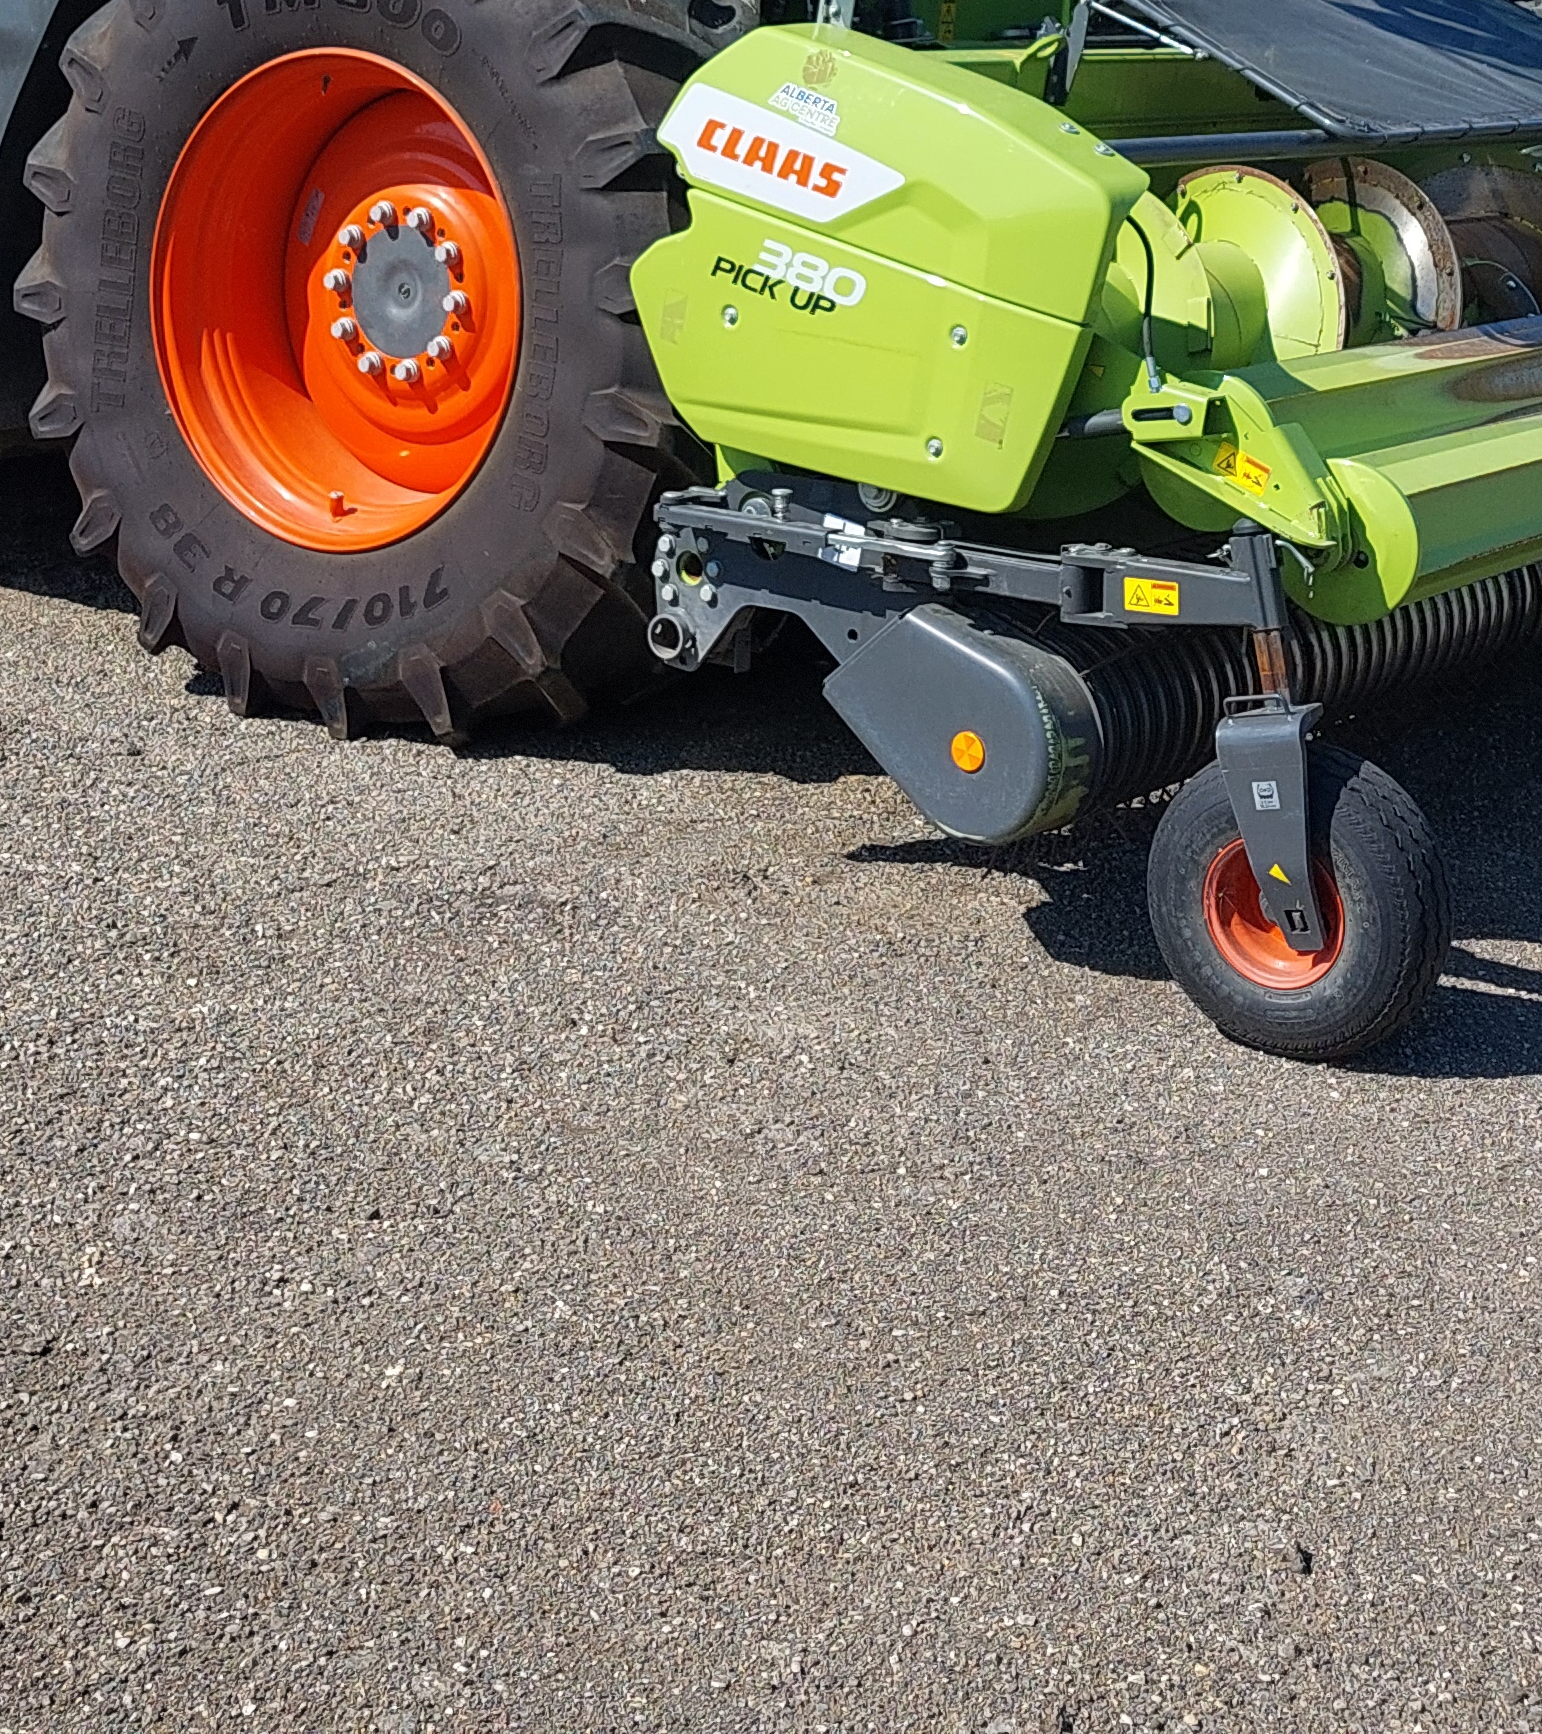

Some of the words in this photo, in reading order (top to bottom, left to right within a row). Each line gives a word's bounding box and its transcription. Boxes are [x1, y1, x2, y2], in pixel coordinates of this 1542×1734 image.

[771, 95, 790, 108] AG
[790, 101, 838, 128] CENTRE
[780, 85, 835, 114] ALBERTA
[697, 118, 848, 198] CLAAS
[90, 106, 146, 413] TRELLEBORG
[711, 256, 785, 301] PICK
[789, 285, 837, 315] UP
[753, 238, 867, 307] 380
[509, 173, 564, 512] TRELLEBORG
